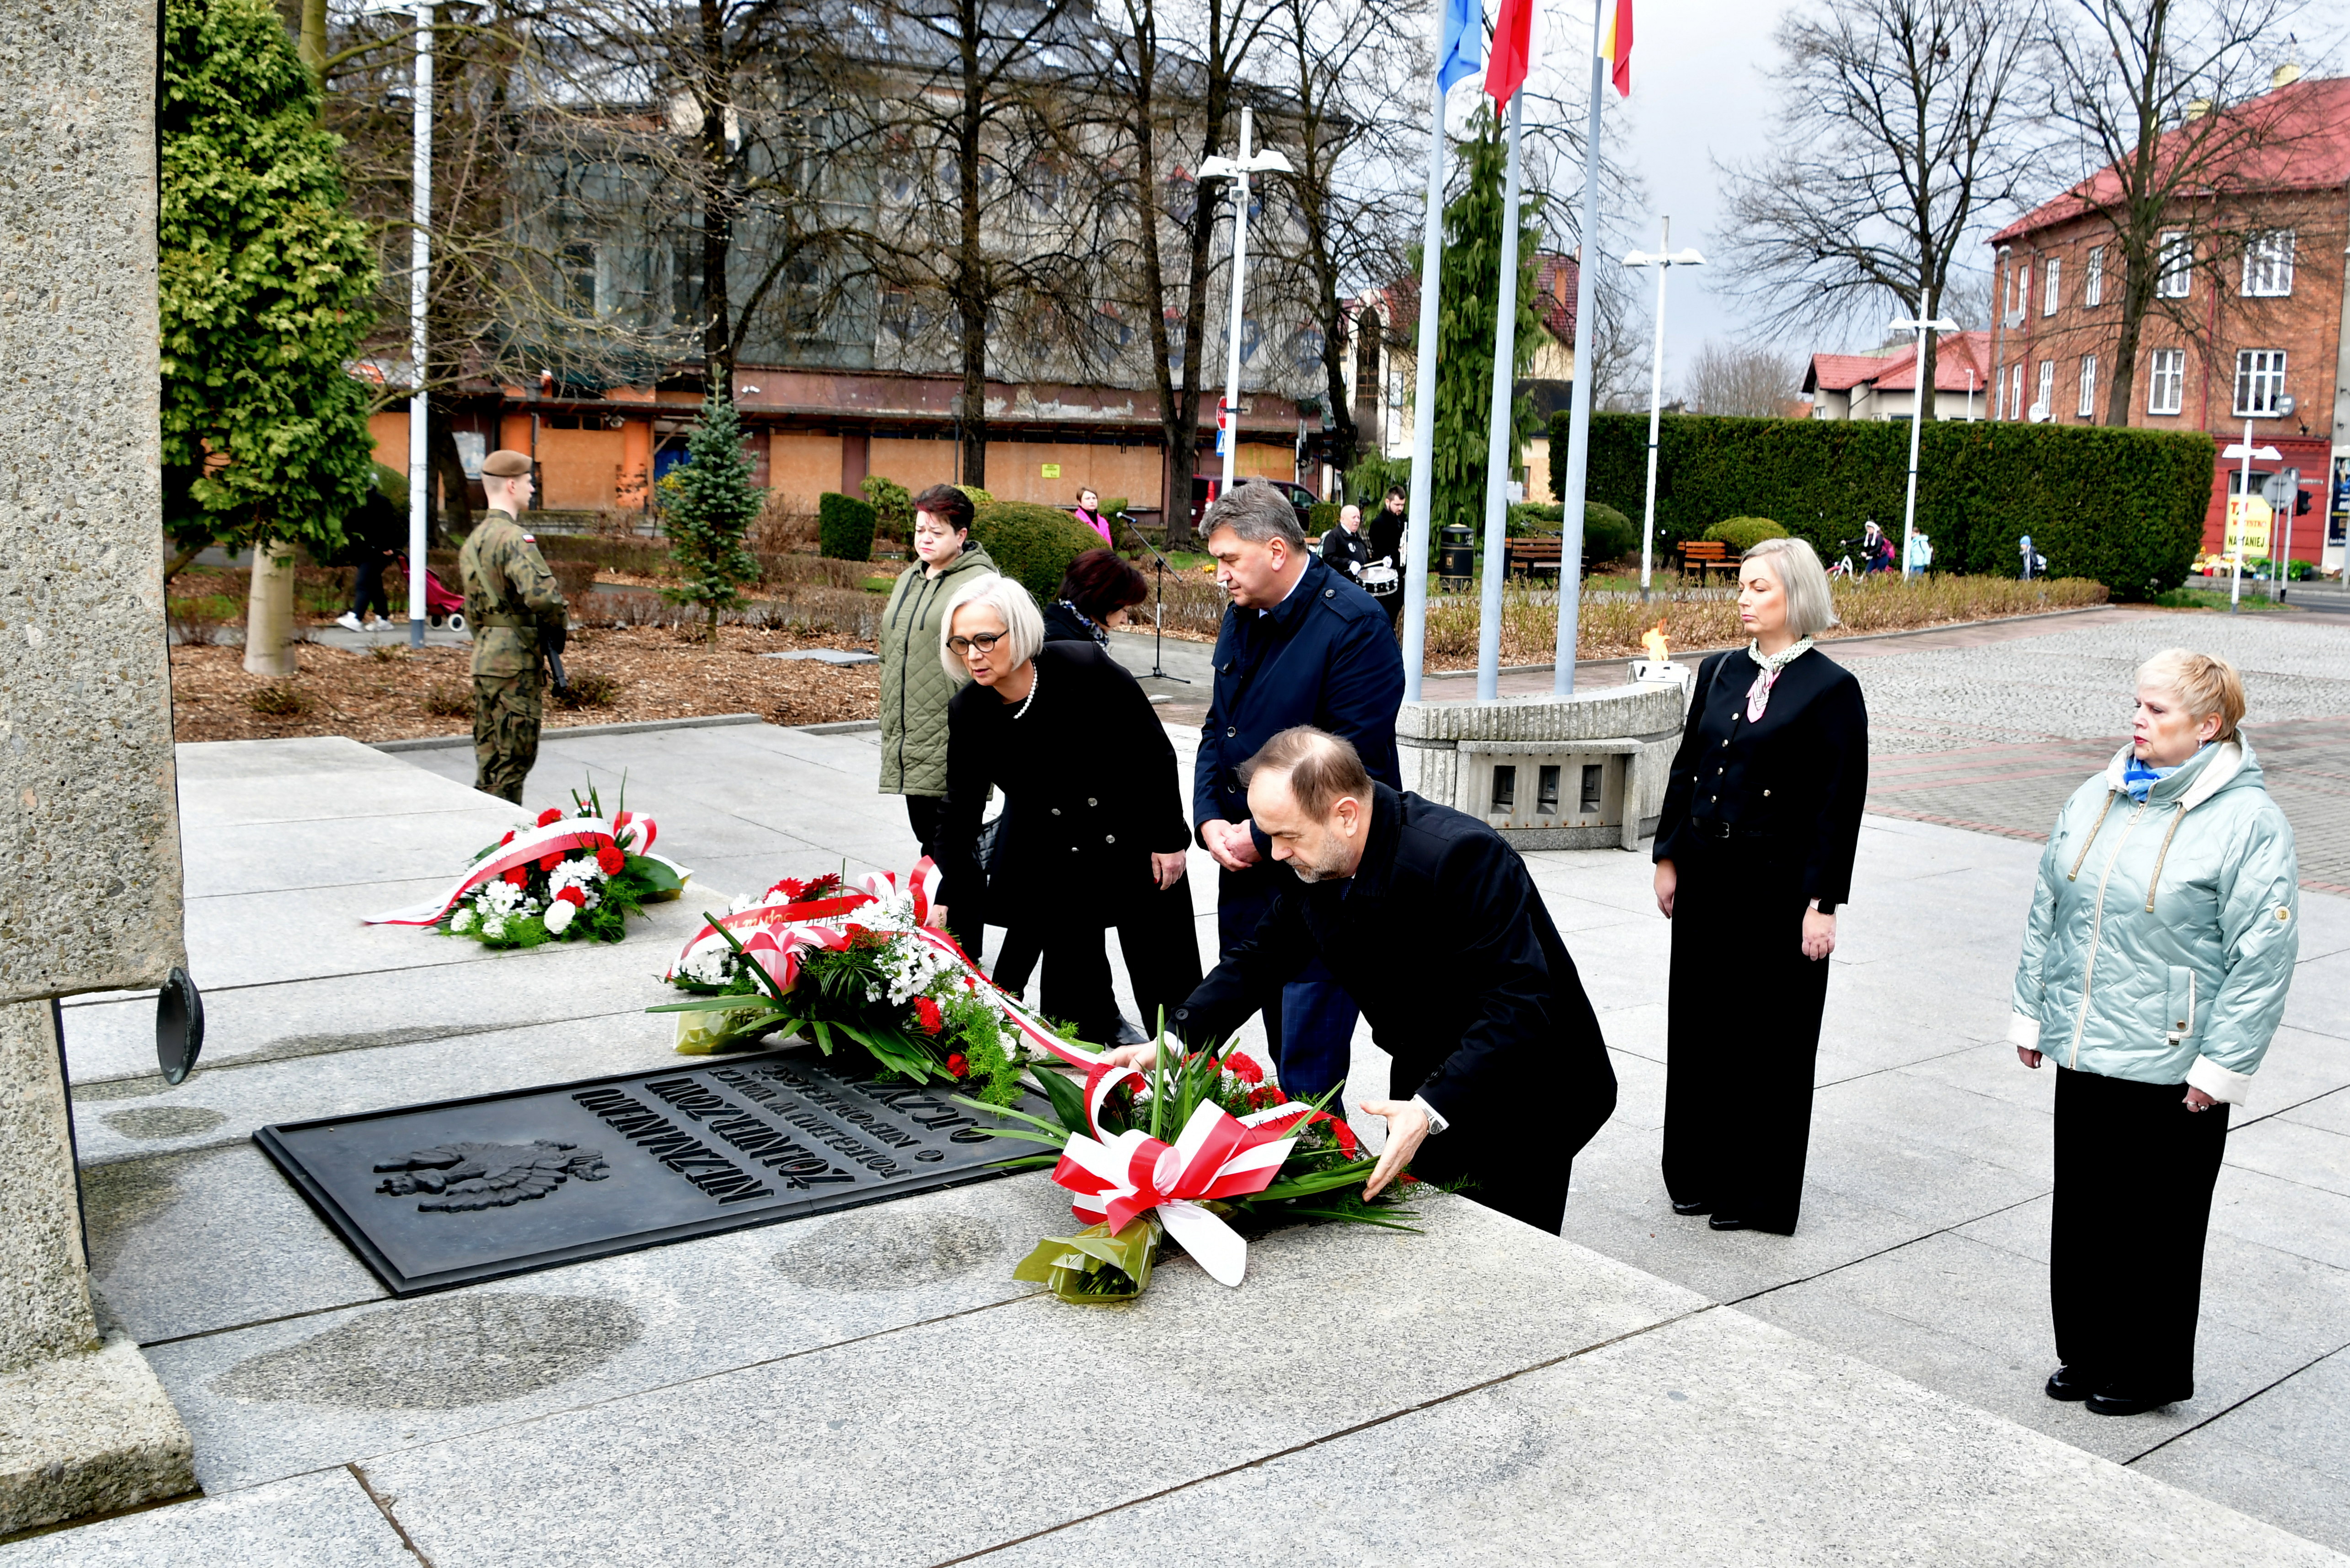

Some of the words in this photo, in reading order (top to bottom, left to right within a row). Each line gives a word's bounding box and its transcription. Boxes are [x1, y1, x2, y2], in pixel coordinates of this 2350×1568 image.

[708, 1066, 777, 1103] WALCE
[763, 1101, 799, 1116] W
[572, 1088, 775, 1206] NIEZNANEMU
[644, 1077, 856, 1190] ŻOŁNIERZOWI
[784, 1113, 912, 1180] POLEGŁEMU
[914, 1149, 945, 1162] O
